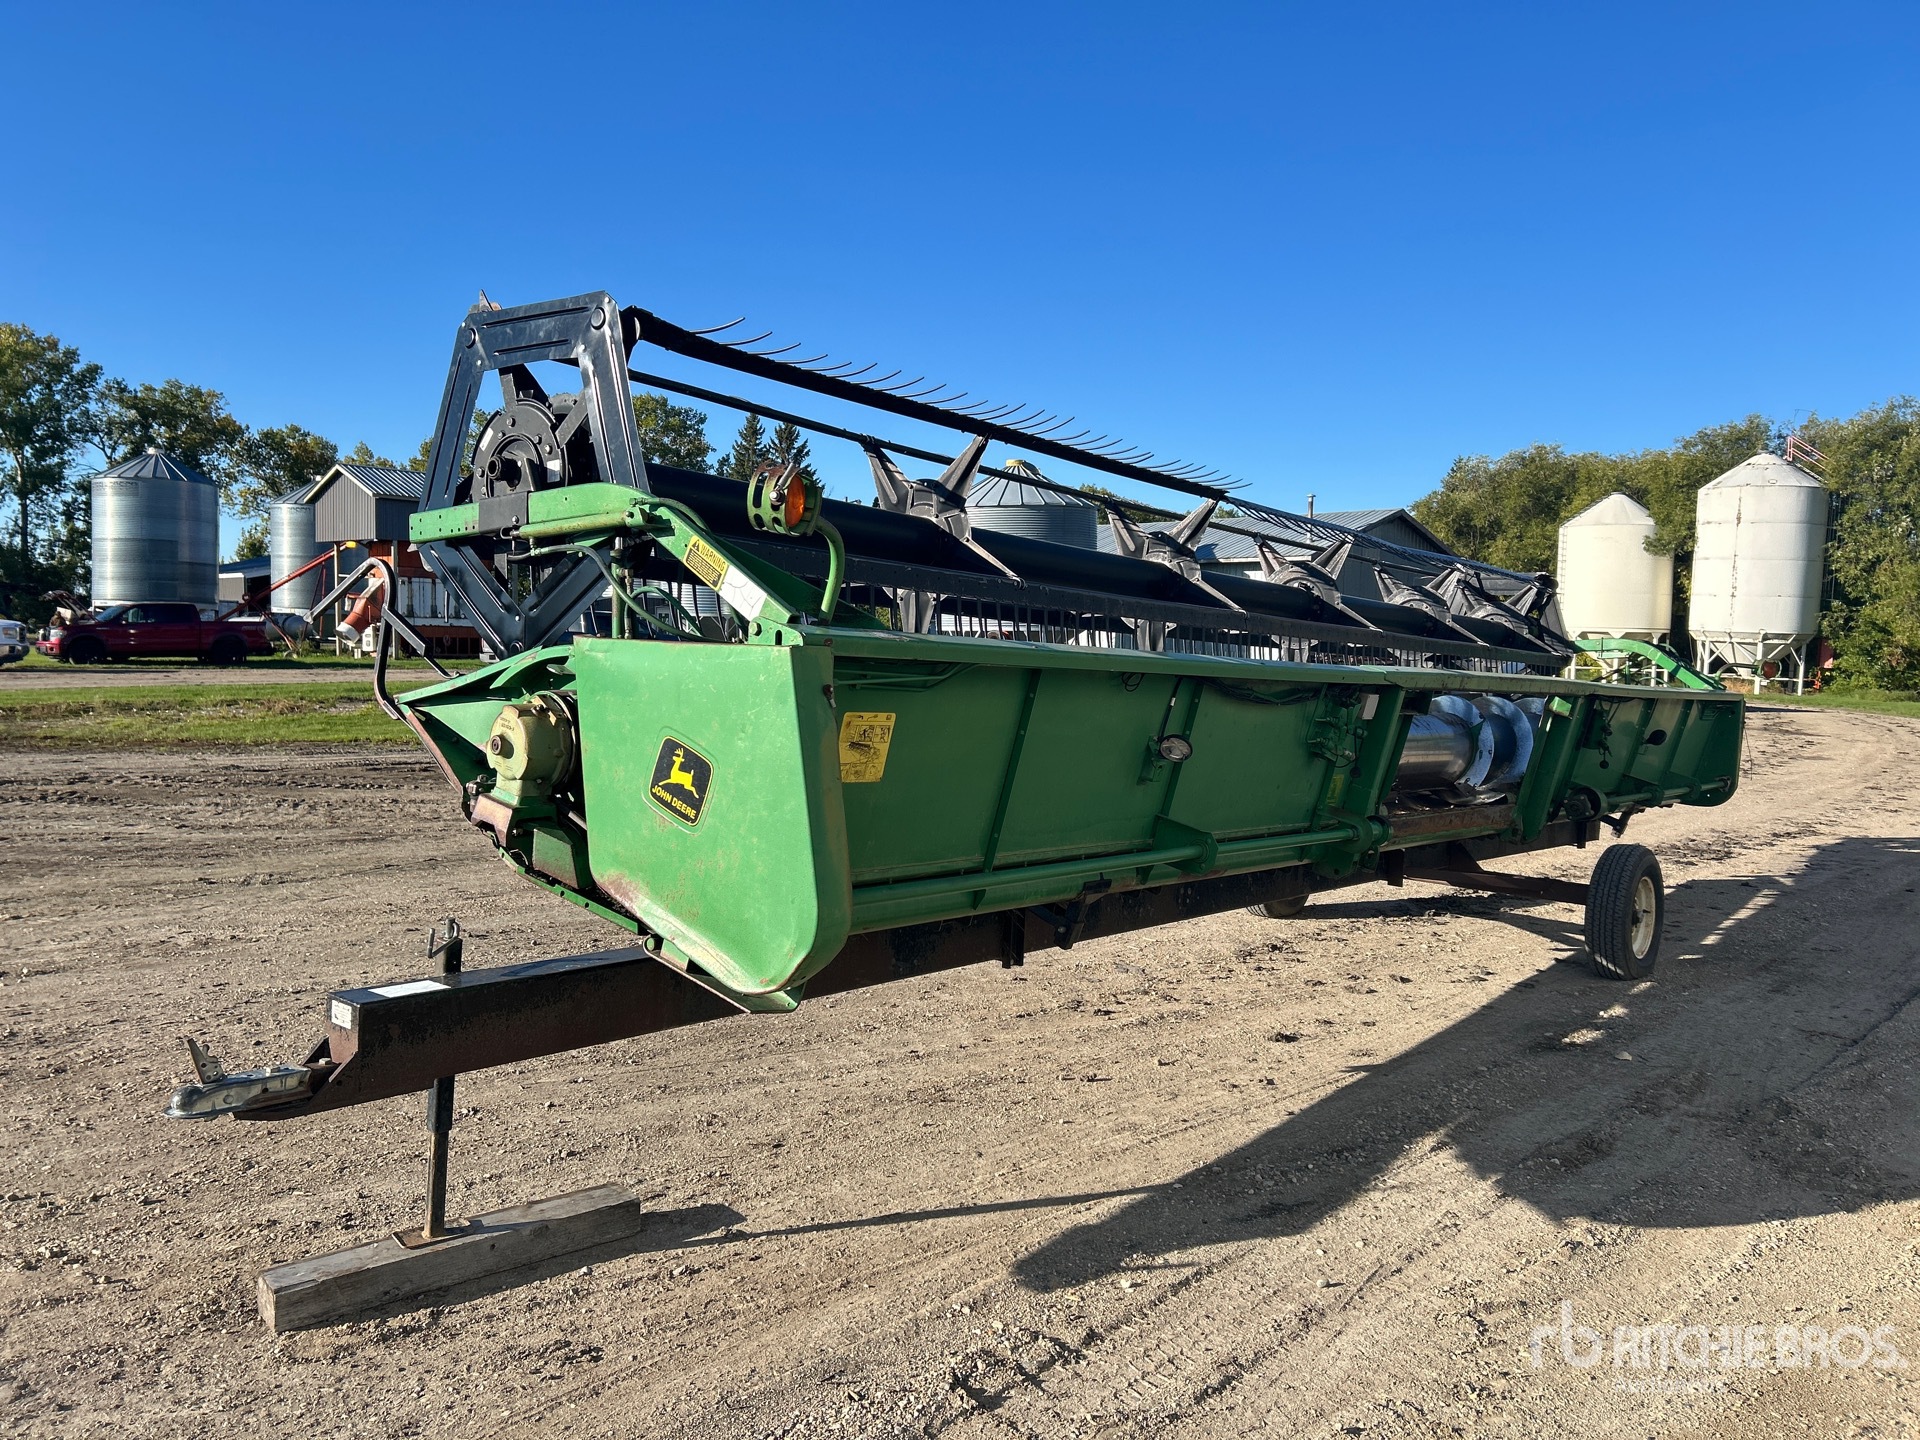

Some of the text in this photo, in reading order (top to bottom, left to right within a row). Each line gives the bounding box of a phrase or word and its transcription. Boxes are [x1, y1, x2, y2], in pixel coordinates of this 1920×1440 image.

[701, 544, 726, 571] WARNING
[652, 785, 697, 819] JOHN DEERE
